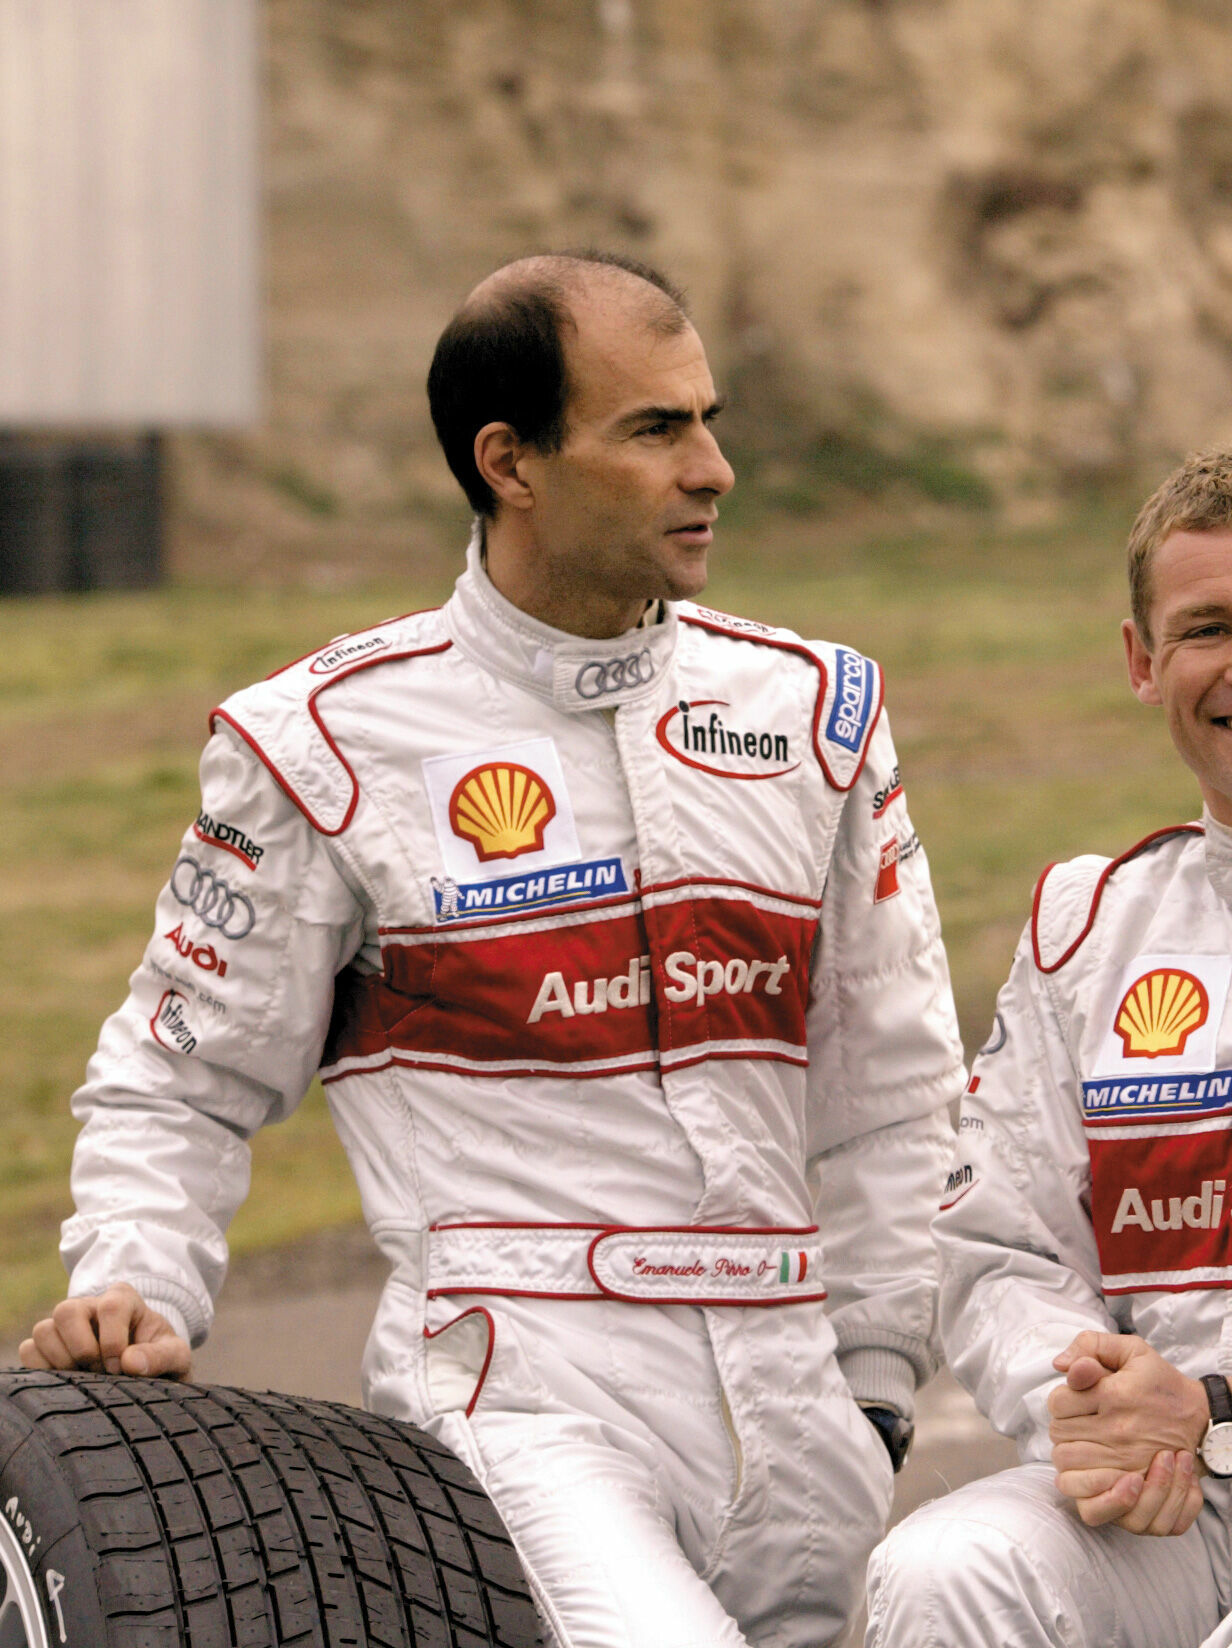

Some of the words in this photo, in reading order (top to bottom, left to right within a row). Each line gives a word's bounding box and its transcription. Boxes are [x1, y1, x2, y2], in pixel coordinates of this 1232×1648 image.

[834, 652, 866, 743] sparco
[197, 809, 264, 865] ANDTLER
[465, 864, 617, 908] MICHELIN
[526, 954, 650, 1024] Audi
[663, 951, 791, 1007] Sport
[1086, 1076, 1232, 1108] MICHELIN
[1110, 1179, 1227, 1234] Audi
